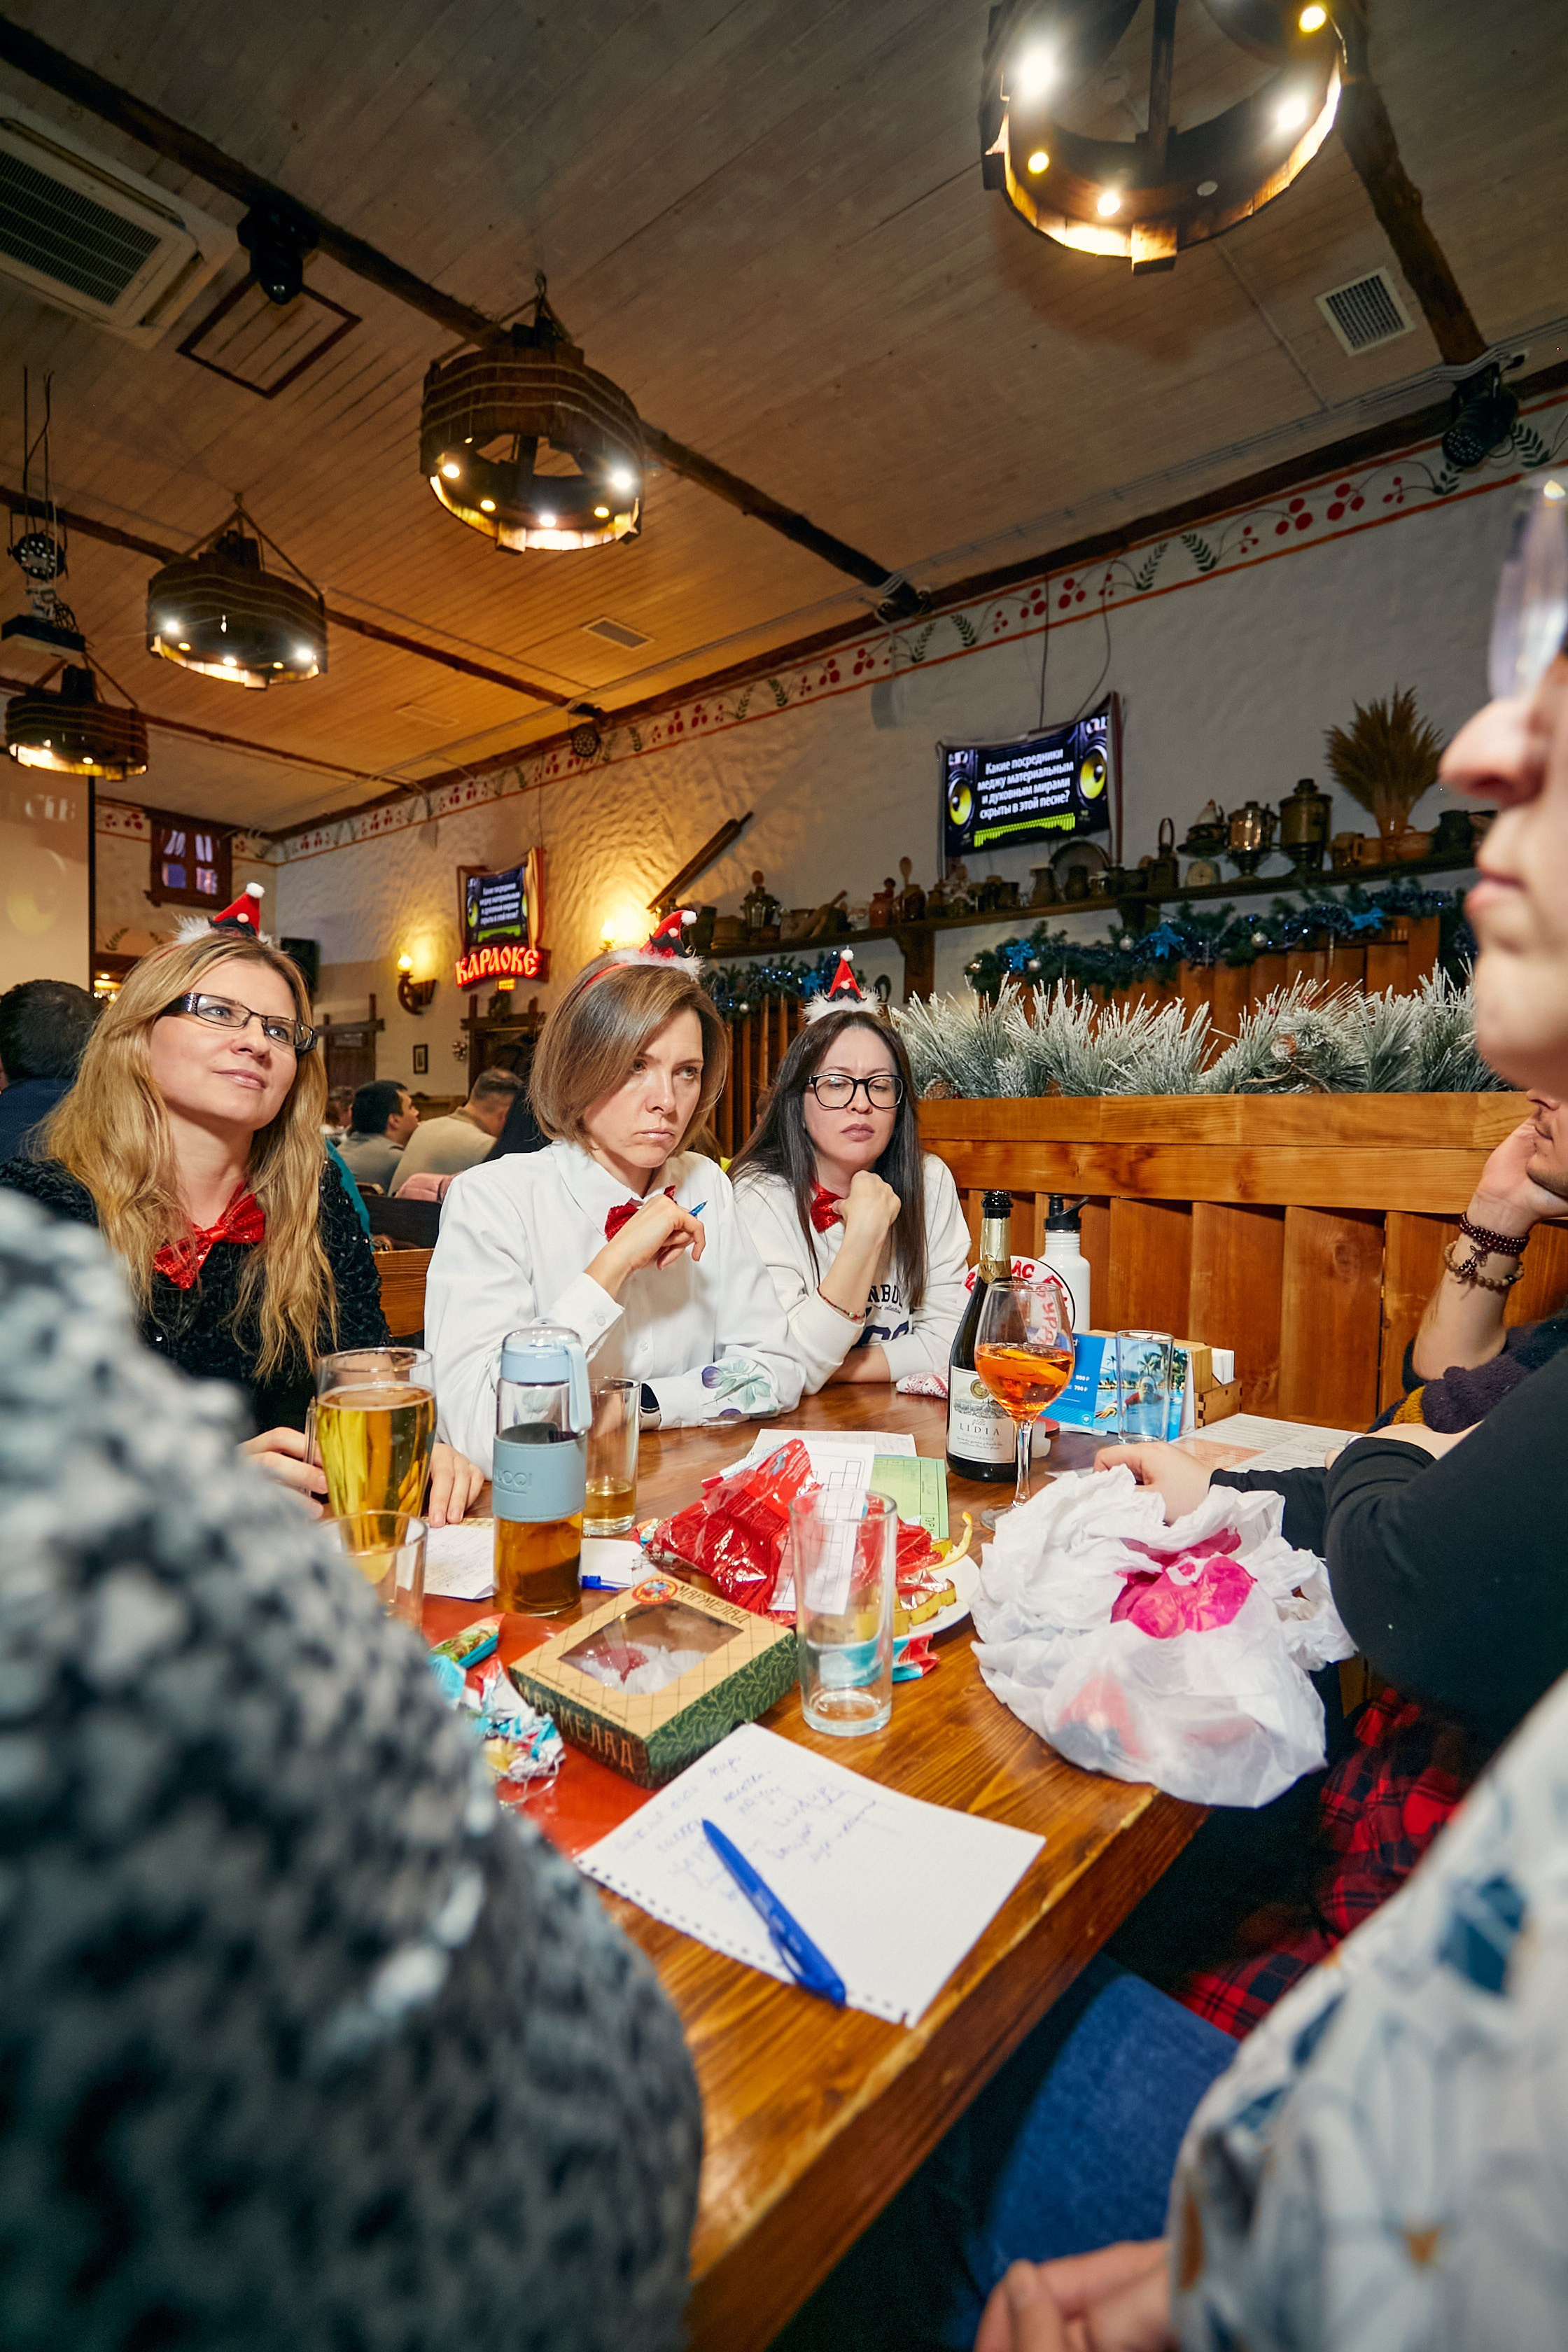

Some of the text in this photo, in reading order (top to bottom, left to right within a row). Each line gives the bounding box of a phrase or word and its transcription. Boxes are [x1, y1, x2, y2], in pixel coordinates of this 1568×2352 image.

[985, 748, 1063, 775] Какие посредники
[1007, 761, 1074, 785] материальным
[979, 789, 1070, 820] скрыты в этой песне?
[981, 777, 1070, 805] и духовным мирами
[455, 946, 541, 987] КАРАОКЕ
[960, 1422, 1000, 1436] LIDIA
[679, 1586, 752, 1624] МАРМЕЛАД
[518, 1682, 635, 1774] МАРМЕЛАД
